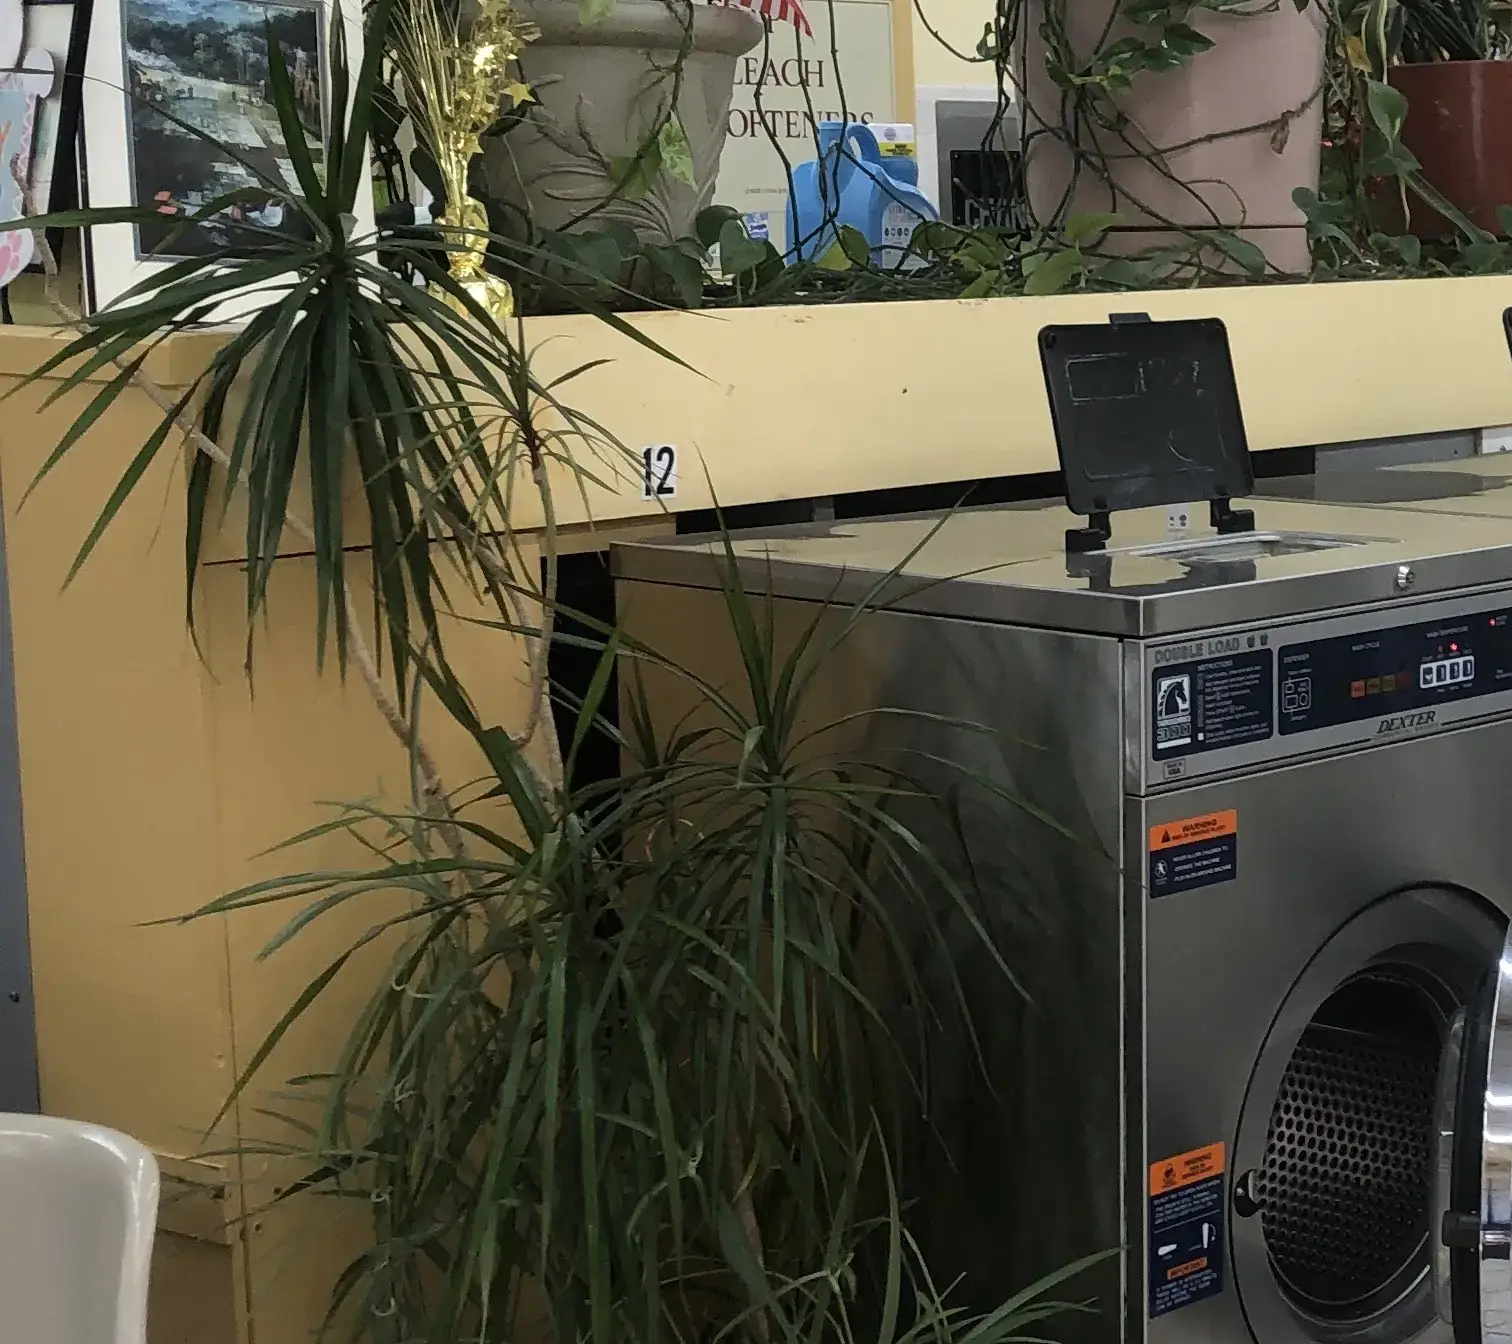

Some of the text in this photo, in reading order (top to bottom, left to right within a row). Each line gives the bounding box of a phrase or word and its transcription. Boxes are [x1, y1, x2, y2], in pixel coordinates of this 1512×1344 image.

[643, 446, 675, 496] 12
[1155, 633, 1240, 663] DOUBLE LOAD
[1377, 711, 1436, 734] DEXTER
